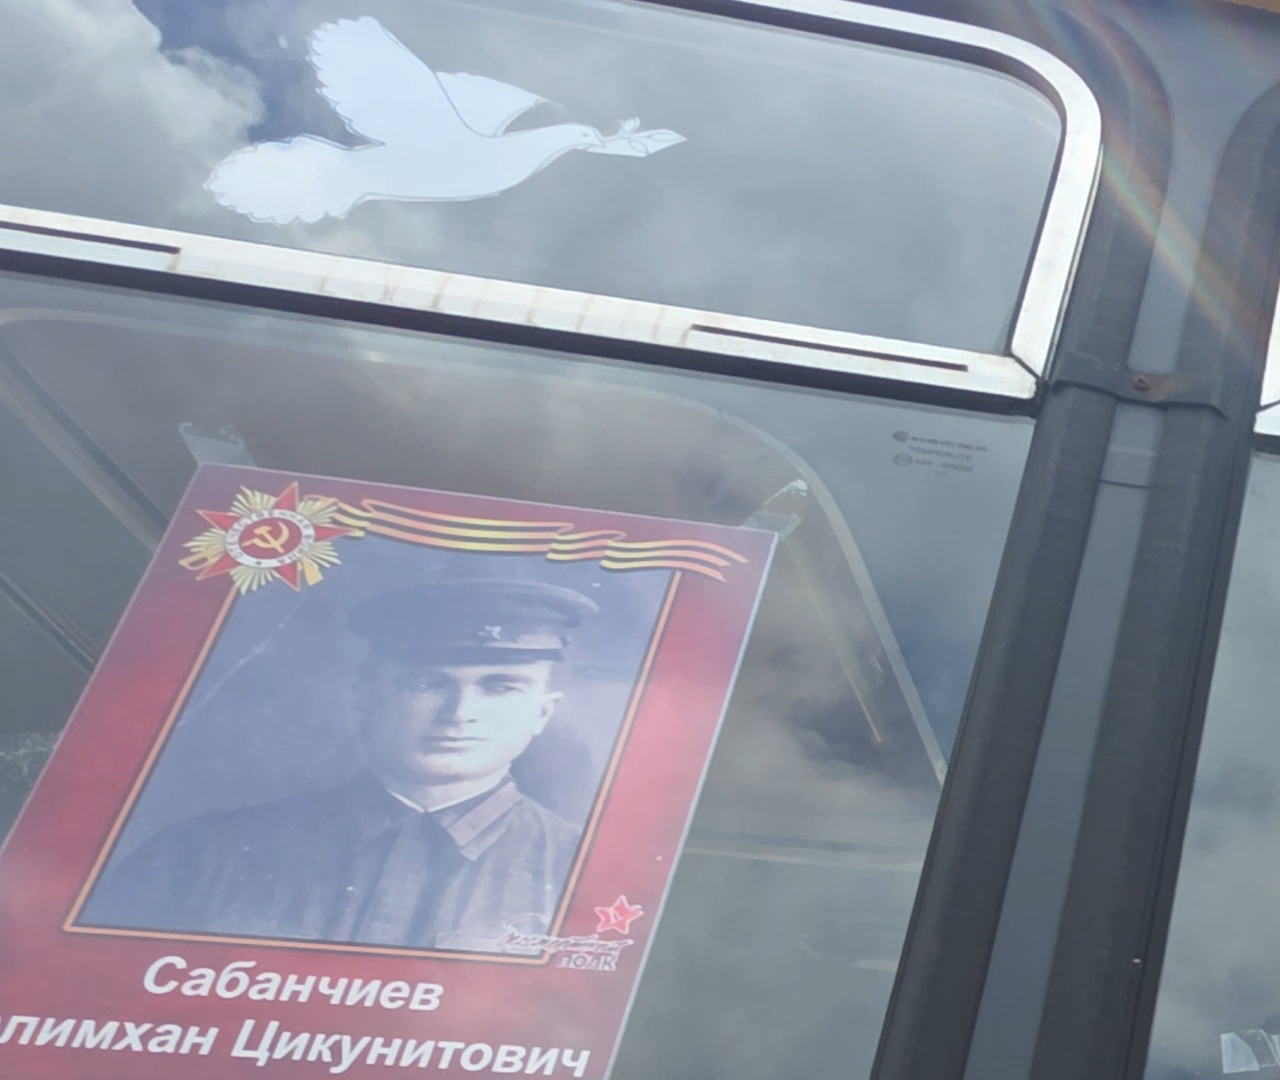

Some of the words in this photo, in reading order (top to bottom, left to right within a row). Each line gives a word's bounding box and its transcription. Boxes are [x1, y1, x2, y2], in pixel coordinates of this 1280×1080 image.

[143, 955, 444, 1011] Сабанчиев
[0, 1015, 219, 1056] лимхан
[230, 1019, 591, 1078] Цикунитович
